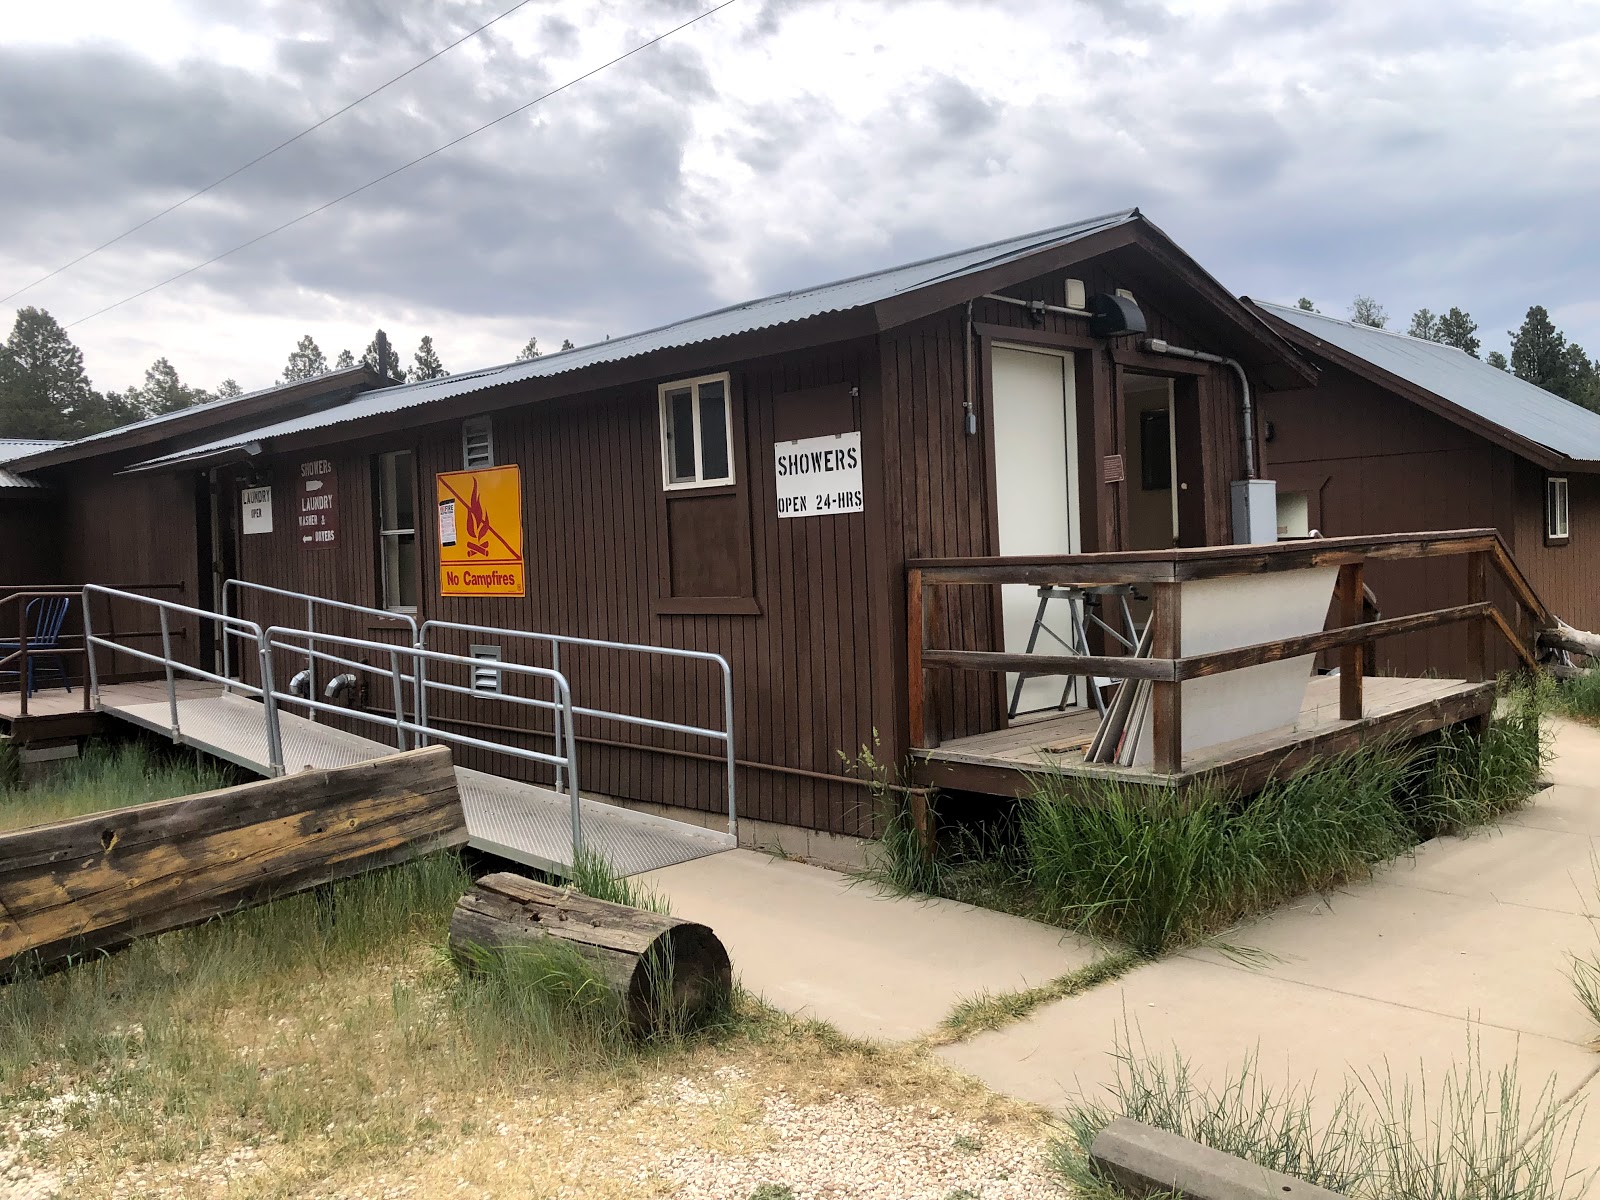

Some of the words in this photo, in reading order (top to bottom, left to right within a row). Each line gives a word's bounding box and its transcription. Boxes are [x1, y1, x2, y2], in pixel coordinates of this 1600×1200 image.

[778, 447, 858, 476] SHOWERS
[243, 489, 270, 504] LAUNDRY
[301, 494, 333, 512] LAUNDRY
[778, 495, 807, 513] OPEN
[816, 490, 862, 510] 24-HRS
[446, 571, 459, 586] No
[463, 570, 515, 588] Campfires
